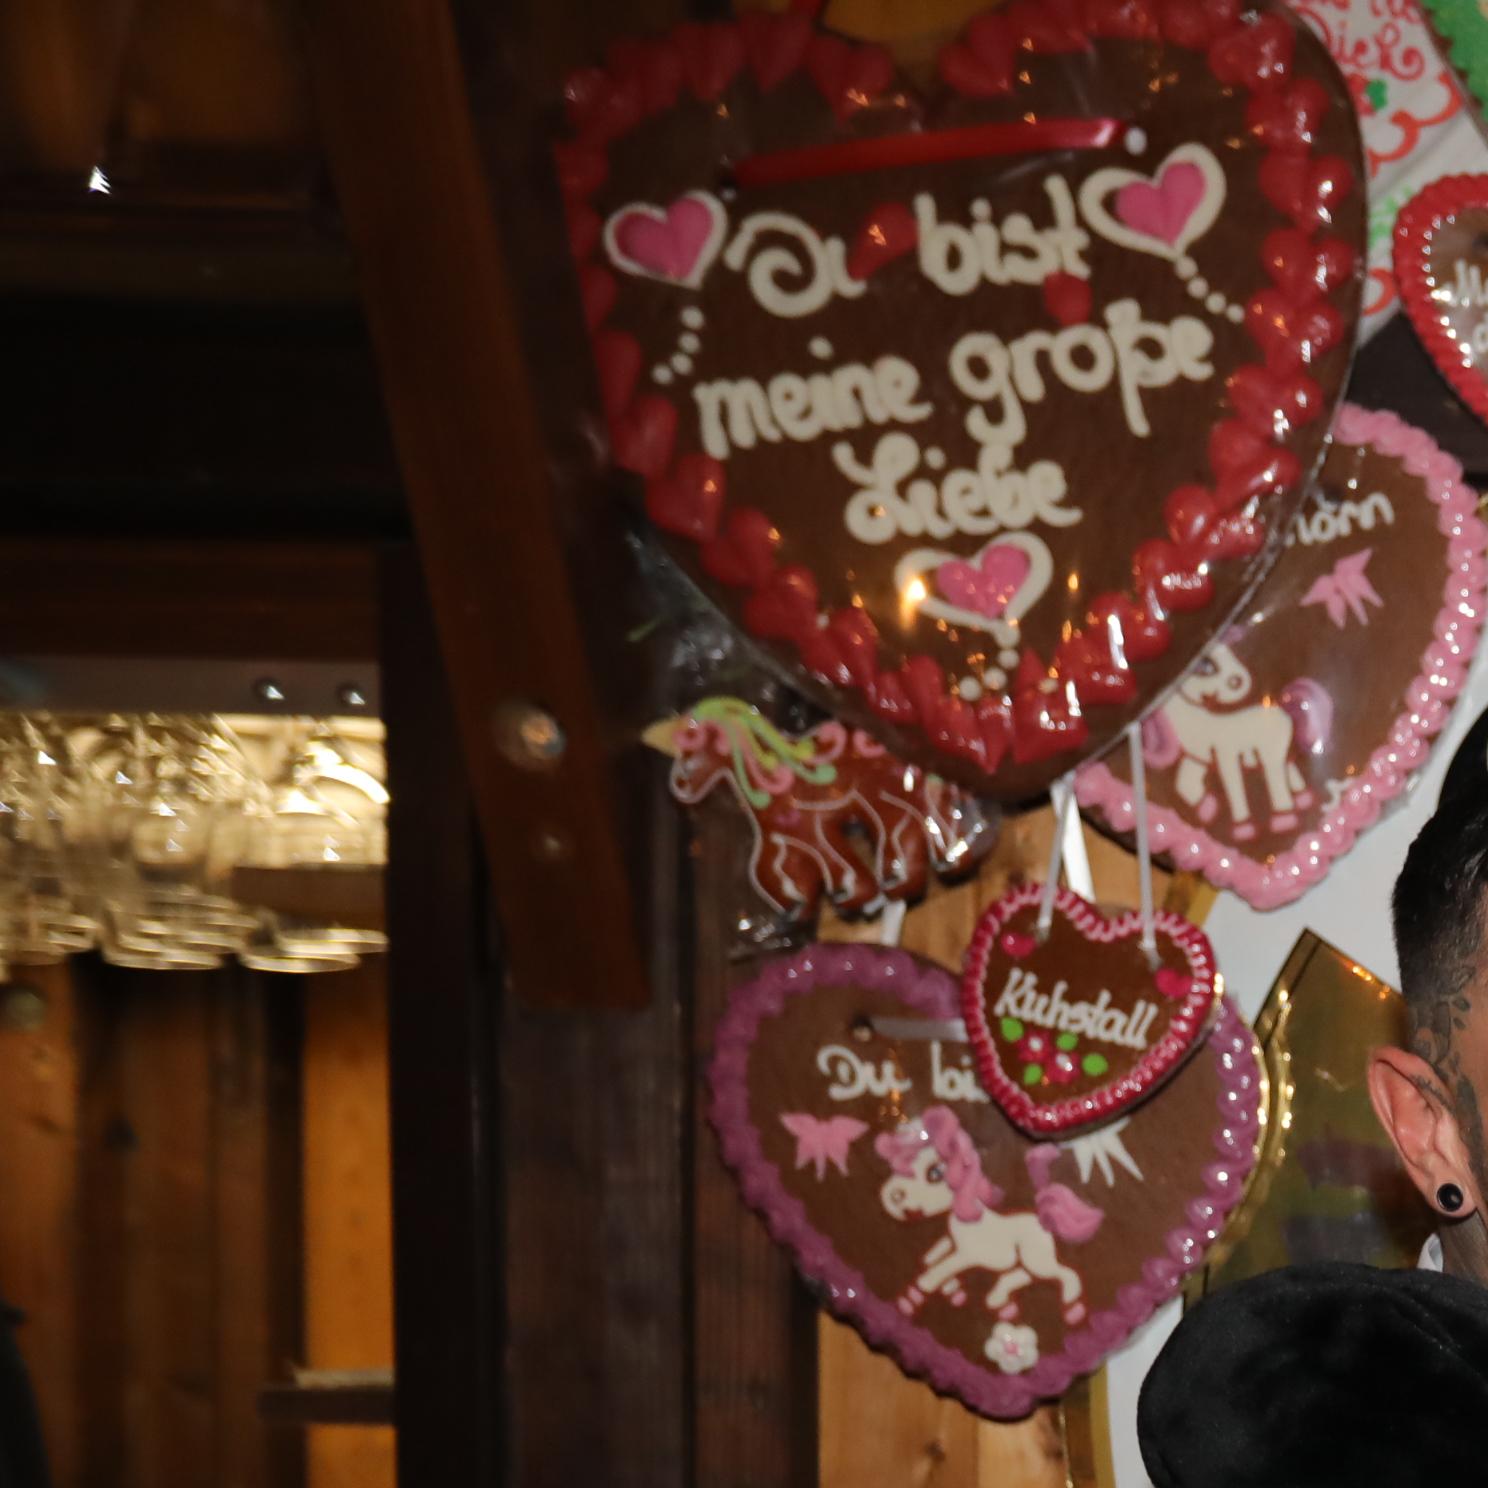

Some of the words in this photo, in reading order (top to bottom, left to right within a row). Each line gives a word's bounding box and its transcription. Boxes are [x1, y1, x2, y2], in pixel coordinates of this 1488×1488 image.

[914, 174, 1091, 295] bist
[693, 336, 934, 460] meine
[832, 431, 1083, 544] Liebe
[994, 967, 1158, 1050] Kuhstall
[817, 1044, 912, 1100] Du
